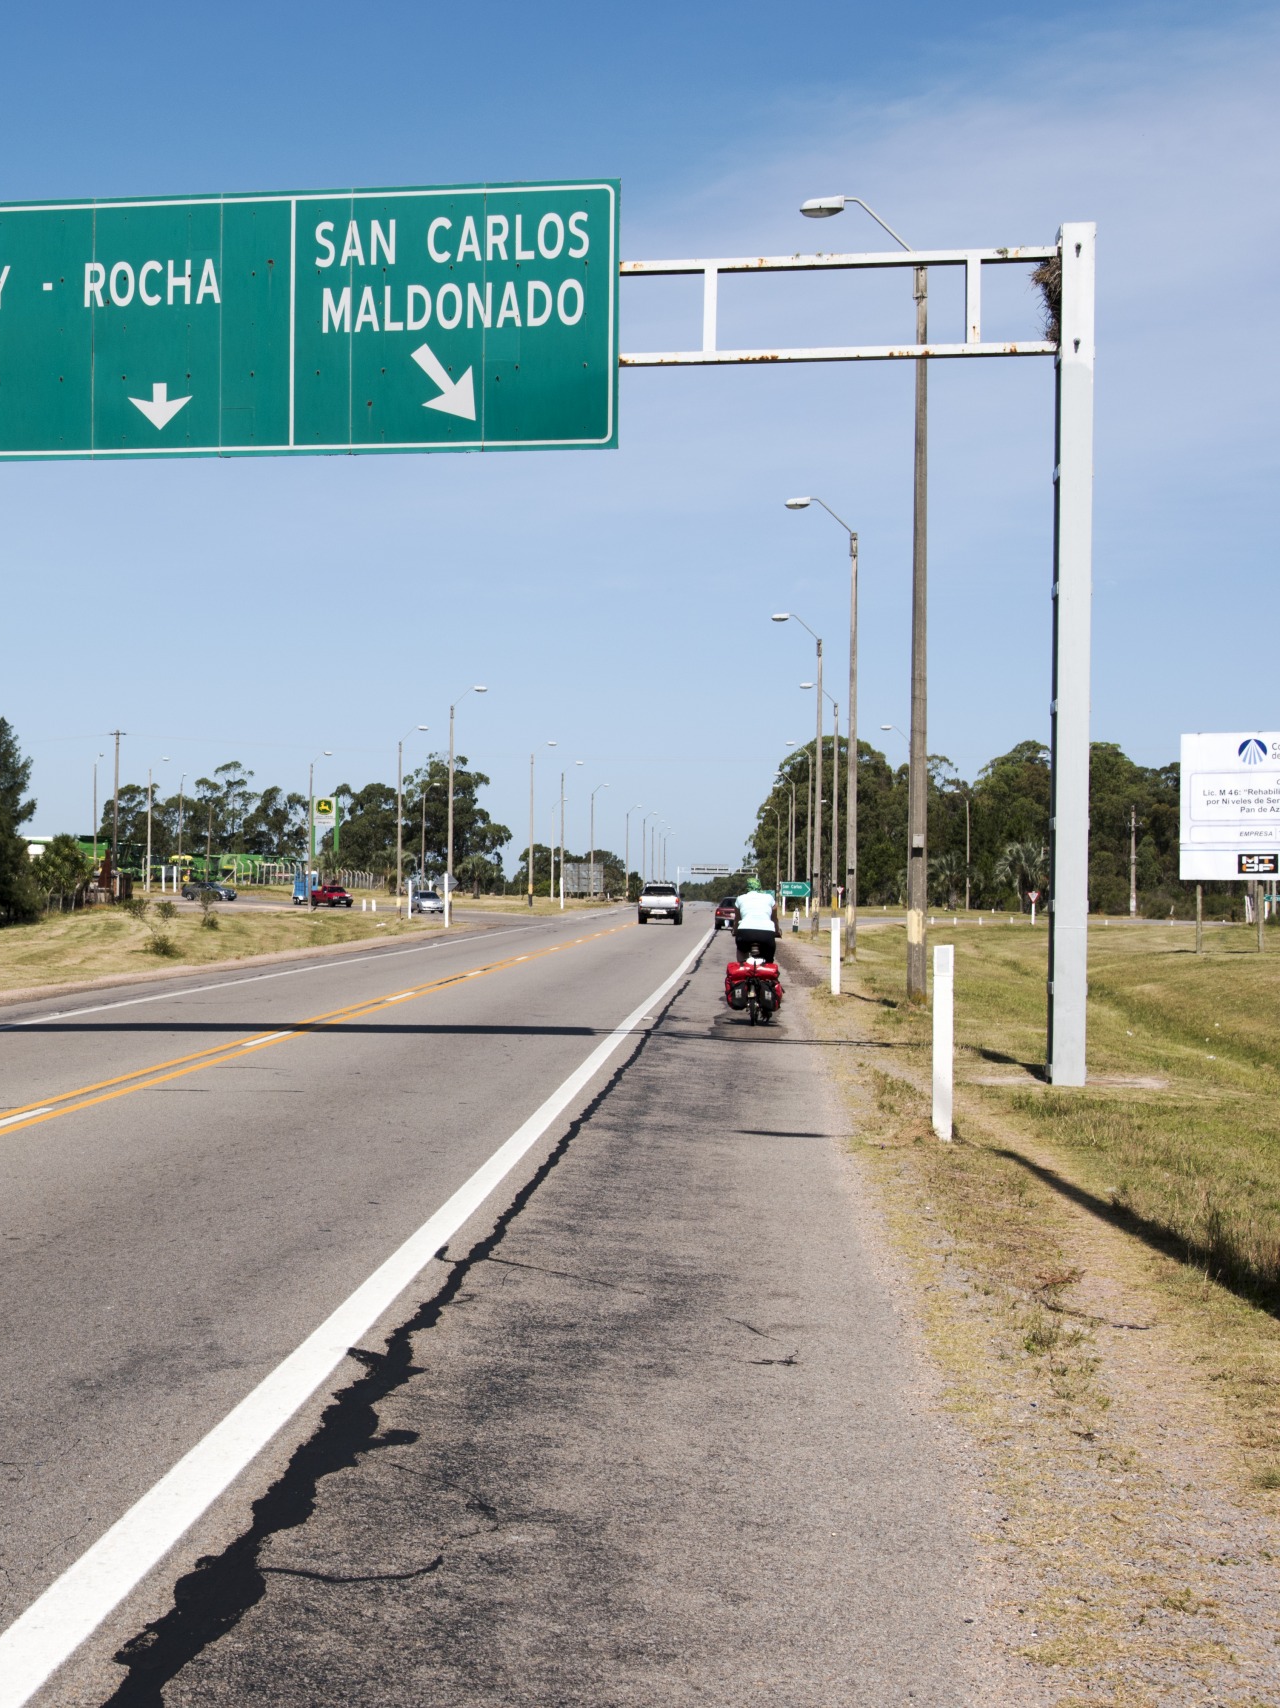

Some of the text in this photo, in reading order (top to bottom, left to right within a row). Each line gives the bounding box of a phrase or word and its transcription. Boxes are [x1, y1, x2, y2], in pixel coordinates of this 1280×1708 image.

[315, 211, 590, 268] SAN CARLOS
[83, 258, 222, 309] ROCHA
[321, 278, 585, 335] MALDONADO
[1254, 797, 1264, 805] de
